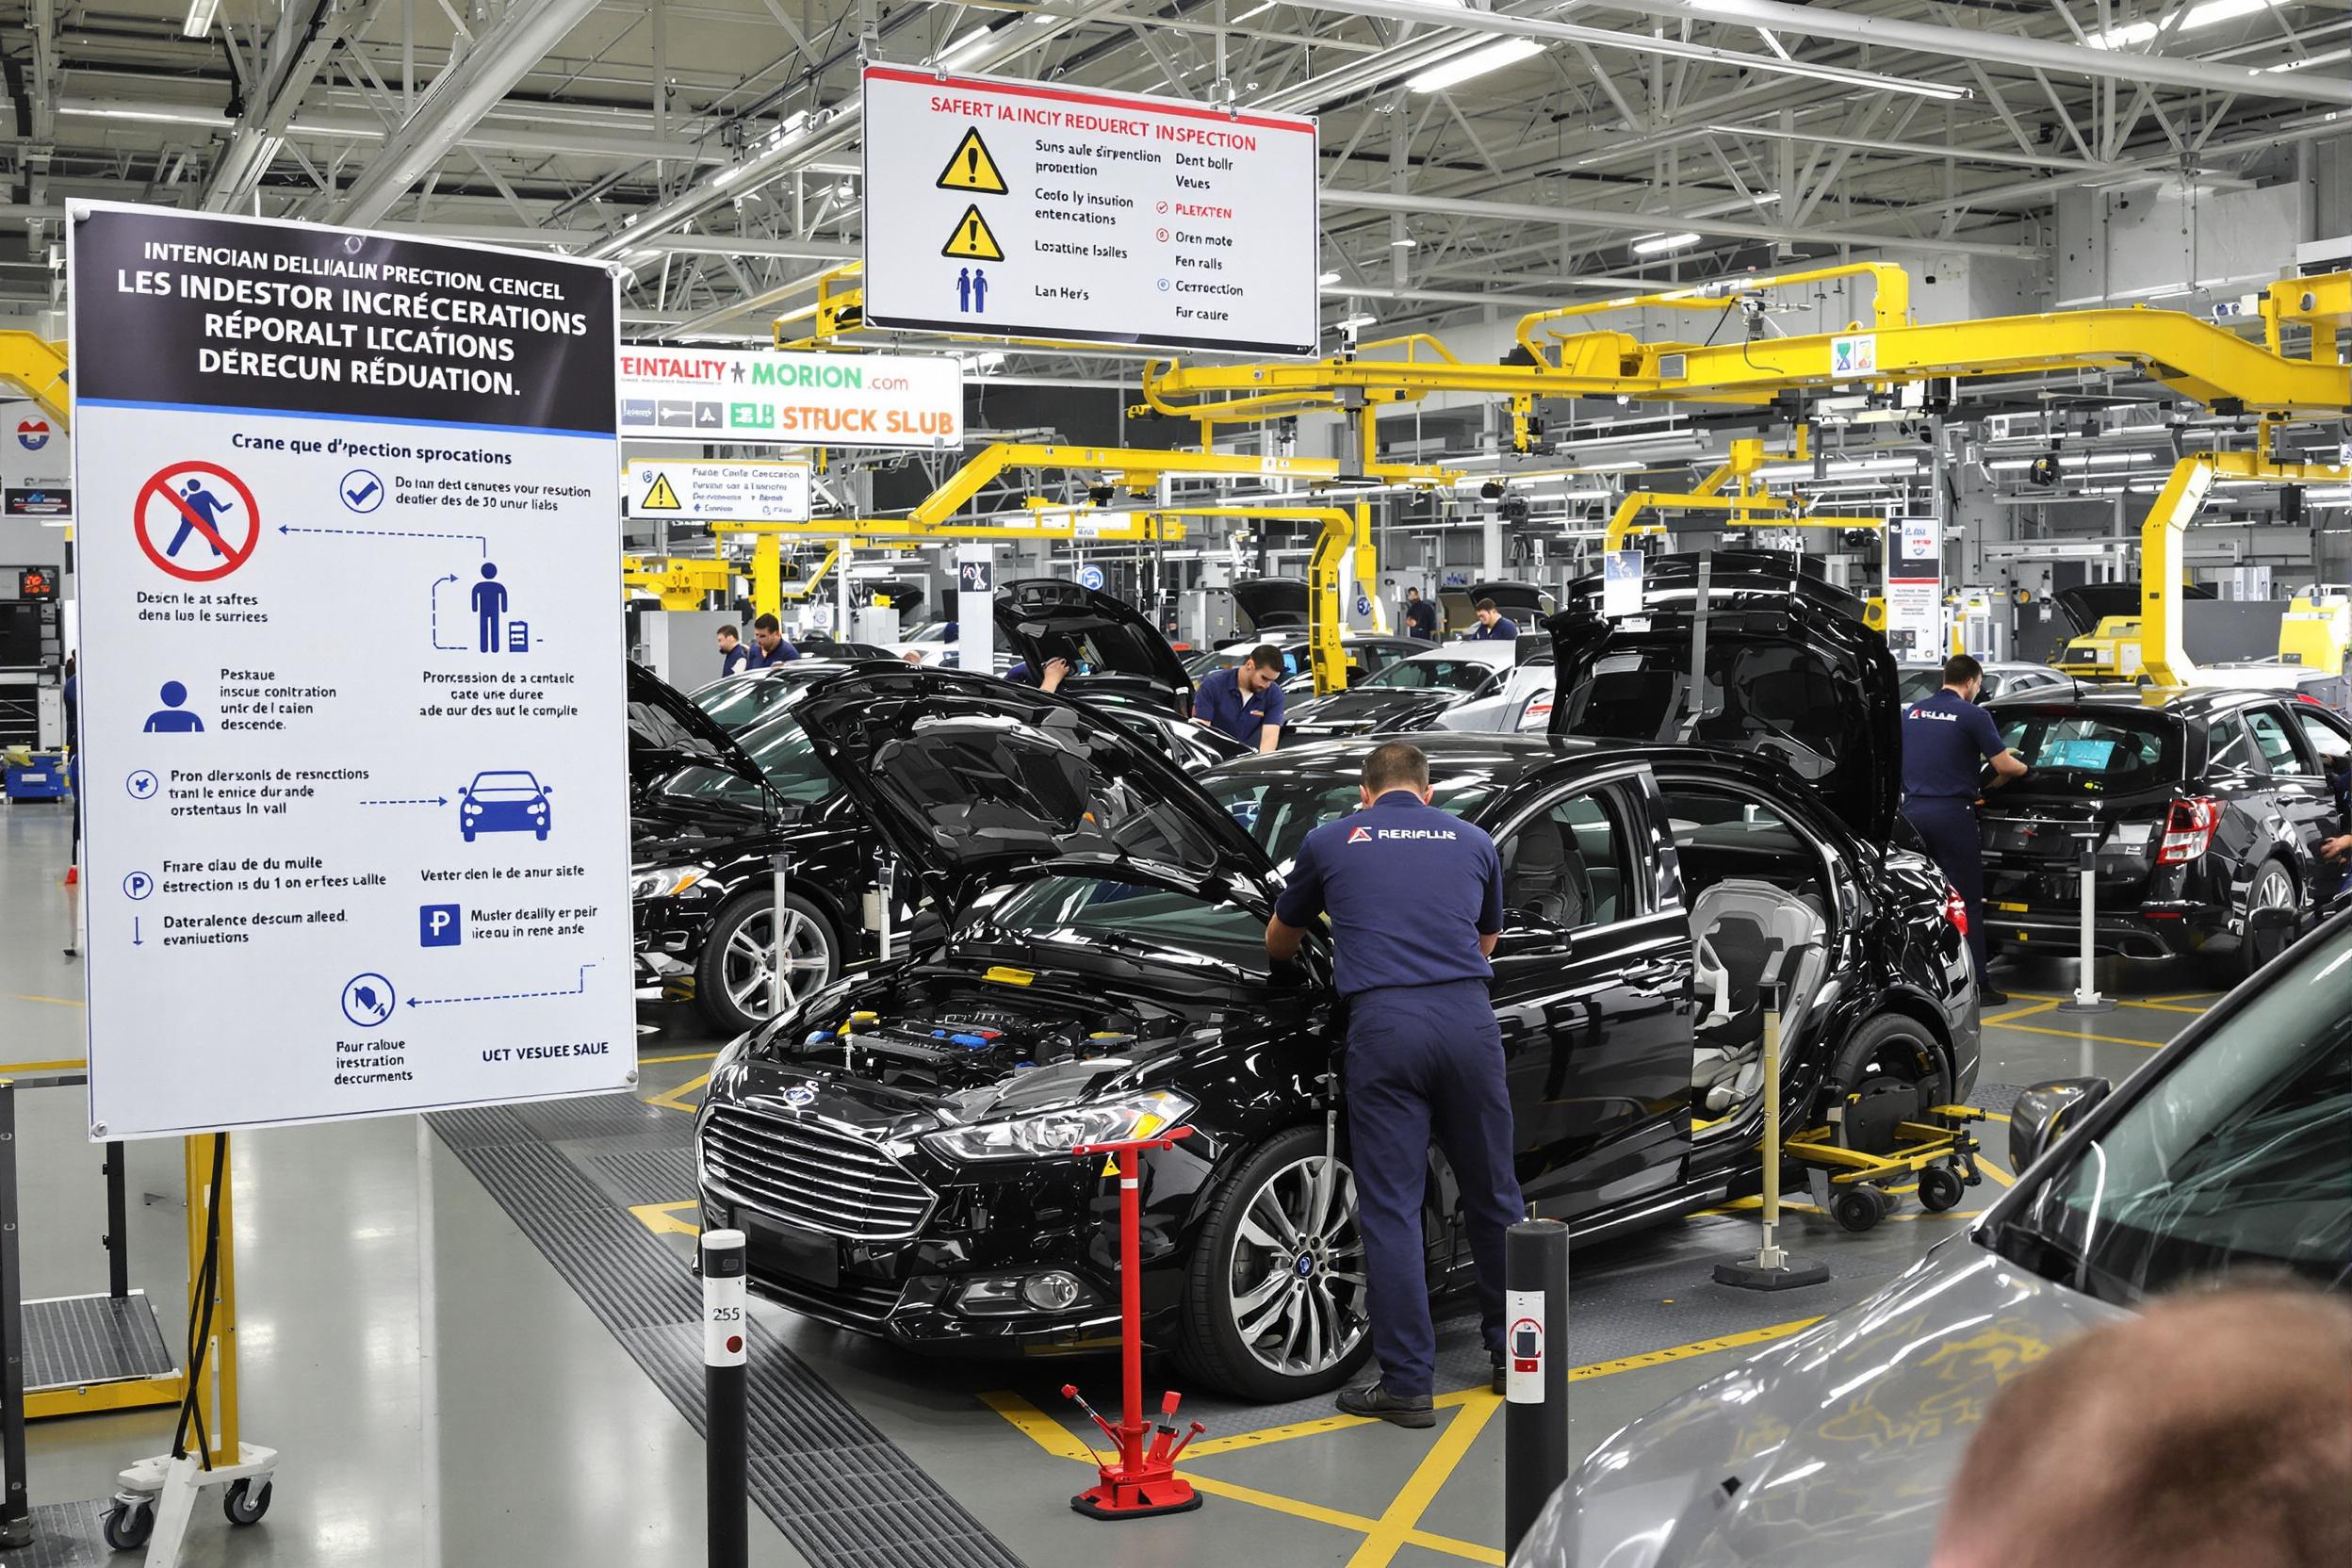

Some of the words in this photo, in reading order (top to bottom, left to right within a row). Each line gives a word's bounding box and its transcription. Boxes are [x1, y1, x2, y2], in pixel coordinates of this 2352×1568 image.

[932, 97, 993, 117] SAFERT
[1156, 125, 1255, 151] INSPECTION
[1036, 139, 1064, 153] Suns
[1176, 154, 1204, 167] Dent
[1176, 255, 1195, 267] Fen
[489, 278, 564, 300] CENCEL
[1036, 286, 1056, 297] Lan
[119, 270, 171, 295] LES
[181, 275, 333, 311] INDESTOR
[341, 288, 586, 337] INCRÉCERATIONS
[1176, 306, 1193, 318] Fur
[205, 308, 358, 347] RÉPORALT
[200, 348, 340, 381] DÉRECUN
[351, 355, 520, 395] RÉDUATION.
[752, 363, 861, 388] MORION
[887, 411, 954, 434] SLUB
[233, 433, 285, 449] Crane
[290, 441, 321, 454] que
[416, 449, 512, 465] sprocations
[396, 476, 412, 488] Do
[544, 486, 590, 498] resution
[441, 495, 461, 506] des
[466, 496, 479, 506] de
[184, 593, 194, 604] le
[200, 596, 211, 604] at
[200, 610, 210, 621] le
[502, 672, 515, 683] de
[519, 705, 529, 715] le
[172, 770, 202, 781] Pron
[276, 769, 291, 780] de
[204, 787, 213, 798] le
[242, 858, 257, 870] de
[263, 858, 279, 869] du
[507, 867, 520, 878] de
[253, 877, 269, 890] du
[575, 906, 597, 920] peir
[164, 915, 247, 928] Dateralence
[514, 926, 523, 937] in
[528, 927, 553, 936] rene
[516, 1045, 570, 1059] VESUEE
[574, 1042, 609, 1055] SAUE
[713, 1308, 740, 1321] 255
